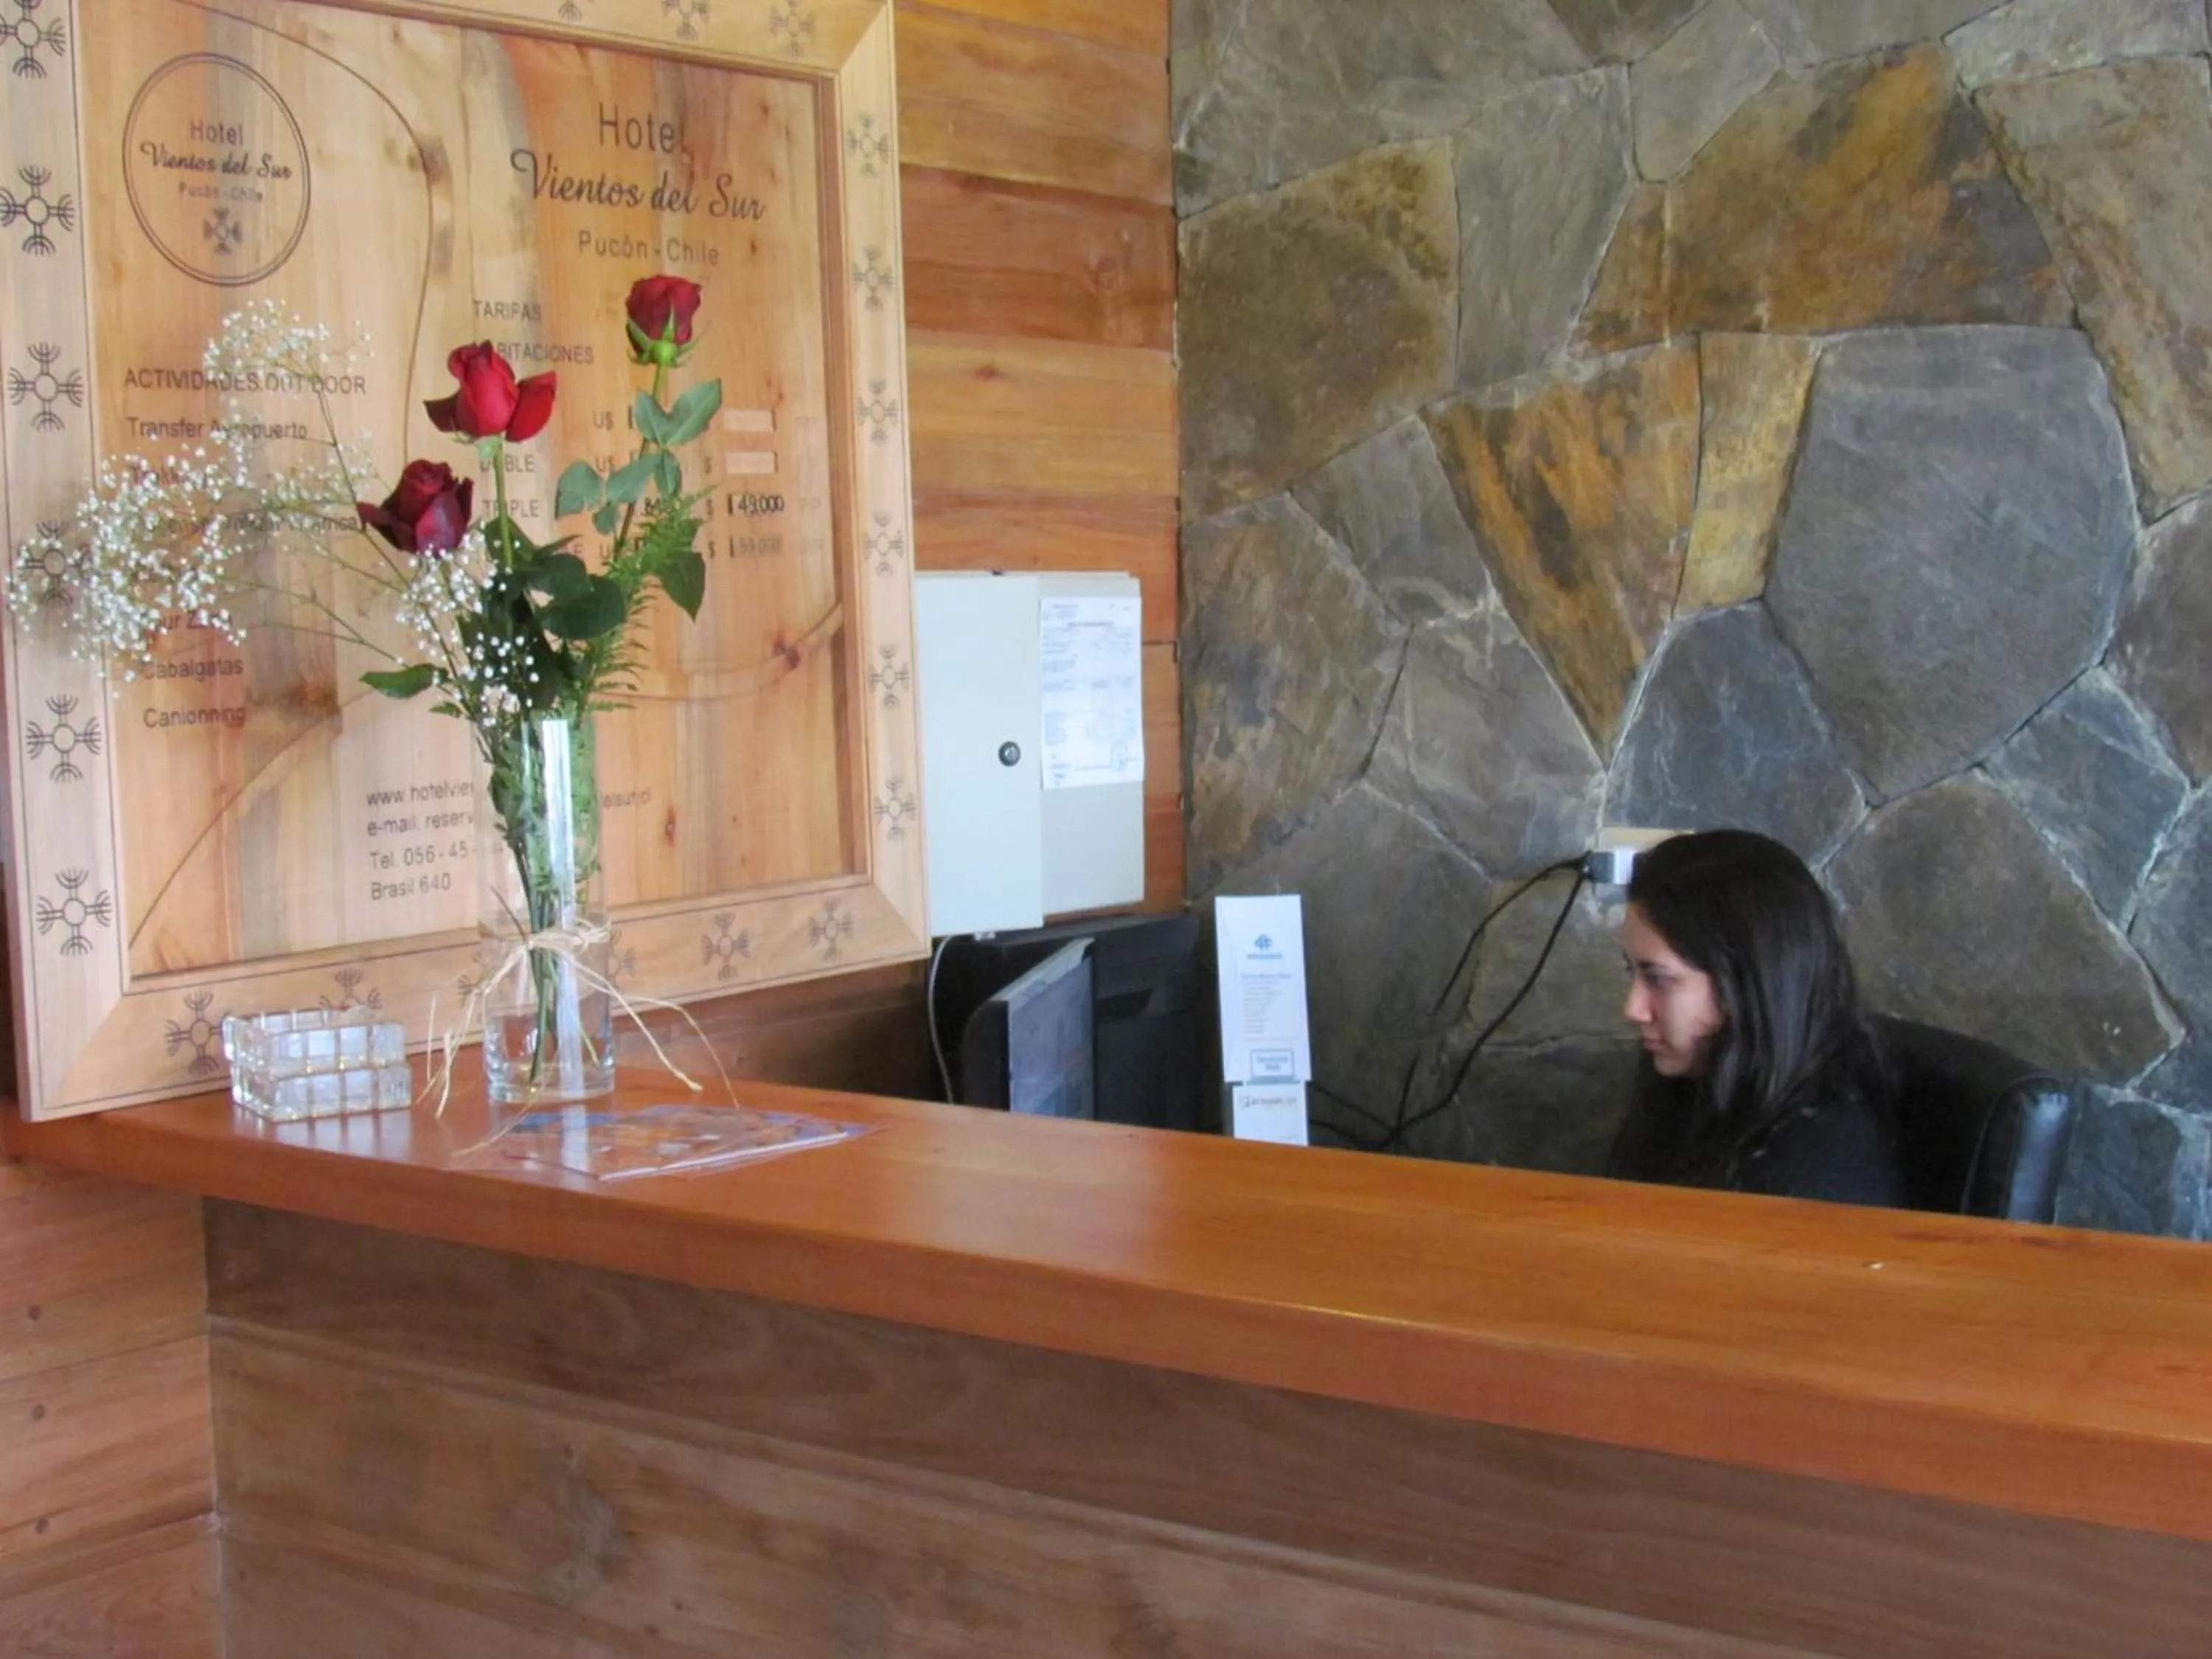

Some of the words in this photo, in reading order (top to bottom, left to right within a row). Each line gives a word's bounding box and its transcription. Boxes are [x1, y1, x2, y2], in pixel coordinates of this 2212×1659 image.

[190, 119, 243, 145] Hotel
[598, 102, 688, 153] Hotel
[140, 141, 217, 172] Vientos
[222, 151, 251, 176] del
[257, 153, 293, 180] Sur
[510, 148, 644, 209] Vientos
[650, 164, 698, 214] del
[708, 173, 767, 221] Sur
[578, 230, 649, 260] Pucón
[667, 237, 720, 266] Chile
[473, 299, 542, 322] TARIFAS
[496, 341, 594, 365] BITACIONES
[126, 417, 204, 438] Transfer
[481, 499, 540, 518] TRPLE
[142, 656, 244, 683] Cabalgatas
[425, 811, 473, 830] reserv
[403, 844, 436, 867] 056
[371, 877, 414, 901] Brasil
[419, 872, 451, 894] 640
